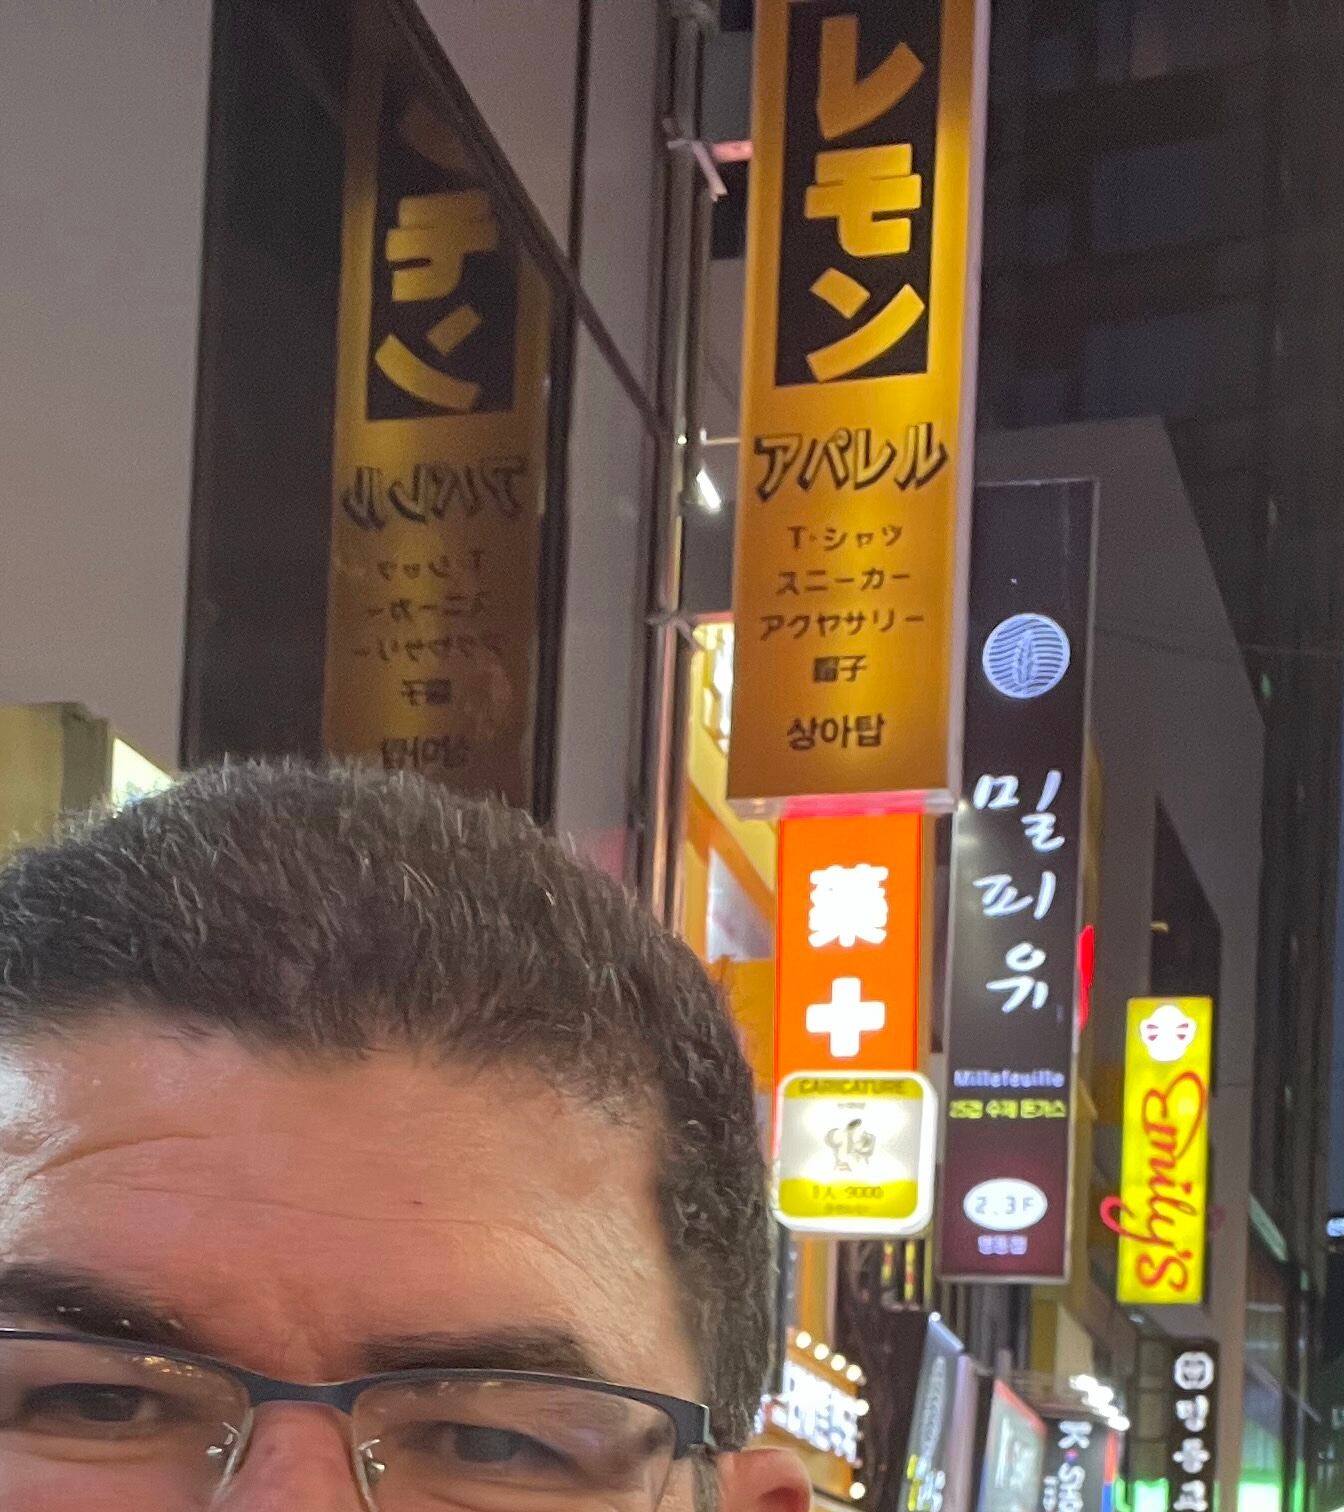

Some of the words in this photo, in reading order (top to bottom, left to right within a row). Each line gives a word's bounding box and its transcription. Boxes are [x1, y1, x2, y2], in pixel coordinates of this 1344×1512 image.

[805, 15, 926, 383] レモン
[754, 421, 949, 502] アパレル
[787, 712, 887, 750] 상아탑
[799, 1079, 904, 1095] CARICATURE
[1100, 1070, 1207, 1292] Emily's
